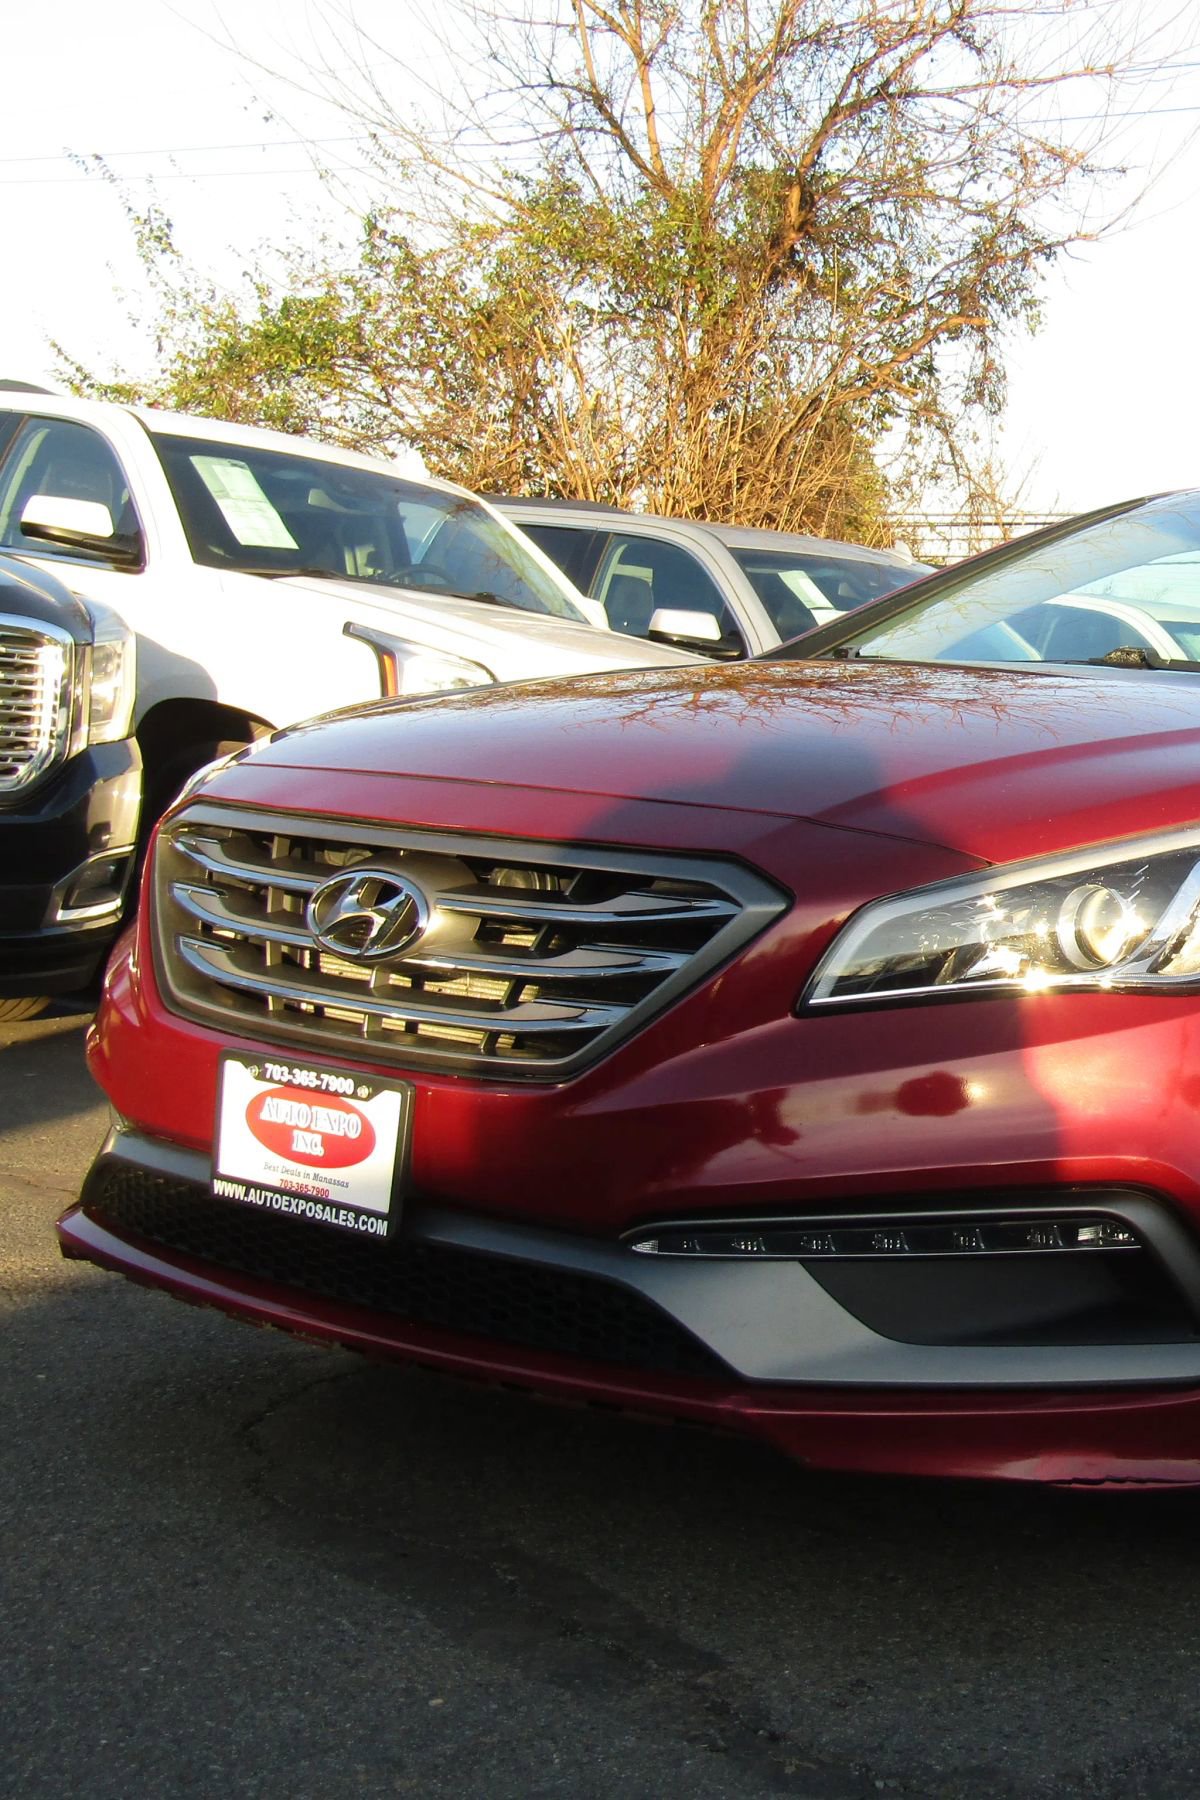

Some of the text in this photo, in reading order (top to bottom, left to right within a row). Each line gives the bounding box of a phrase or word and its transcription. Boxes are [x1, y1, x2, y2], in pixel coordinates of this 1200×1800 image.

[264, 1062, 355, 1095] 703-365-7900
[260, 1096, 311, 1129] AUTO
[263, 1161, 350, 1189] Best Deals in Manassas
[279, 1178, 330, 1198] 703-365-7900
[213, 1178, 389, 1237] WWW.AUTOEXPOSALES.COM
